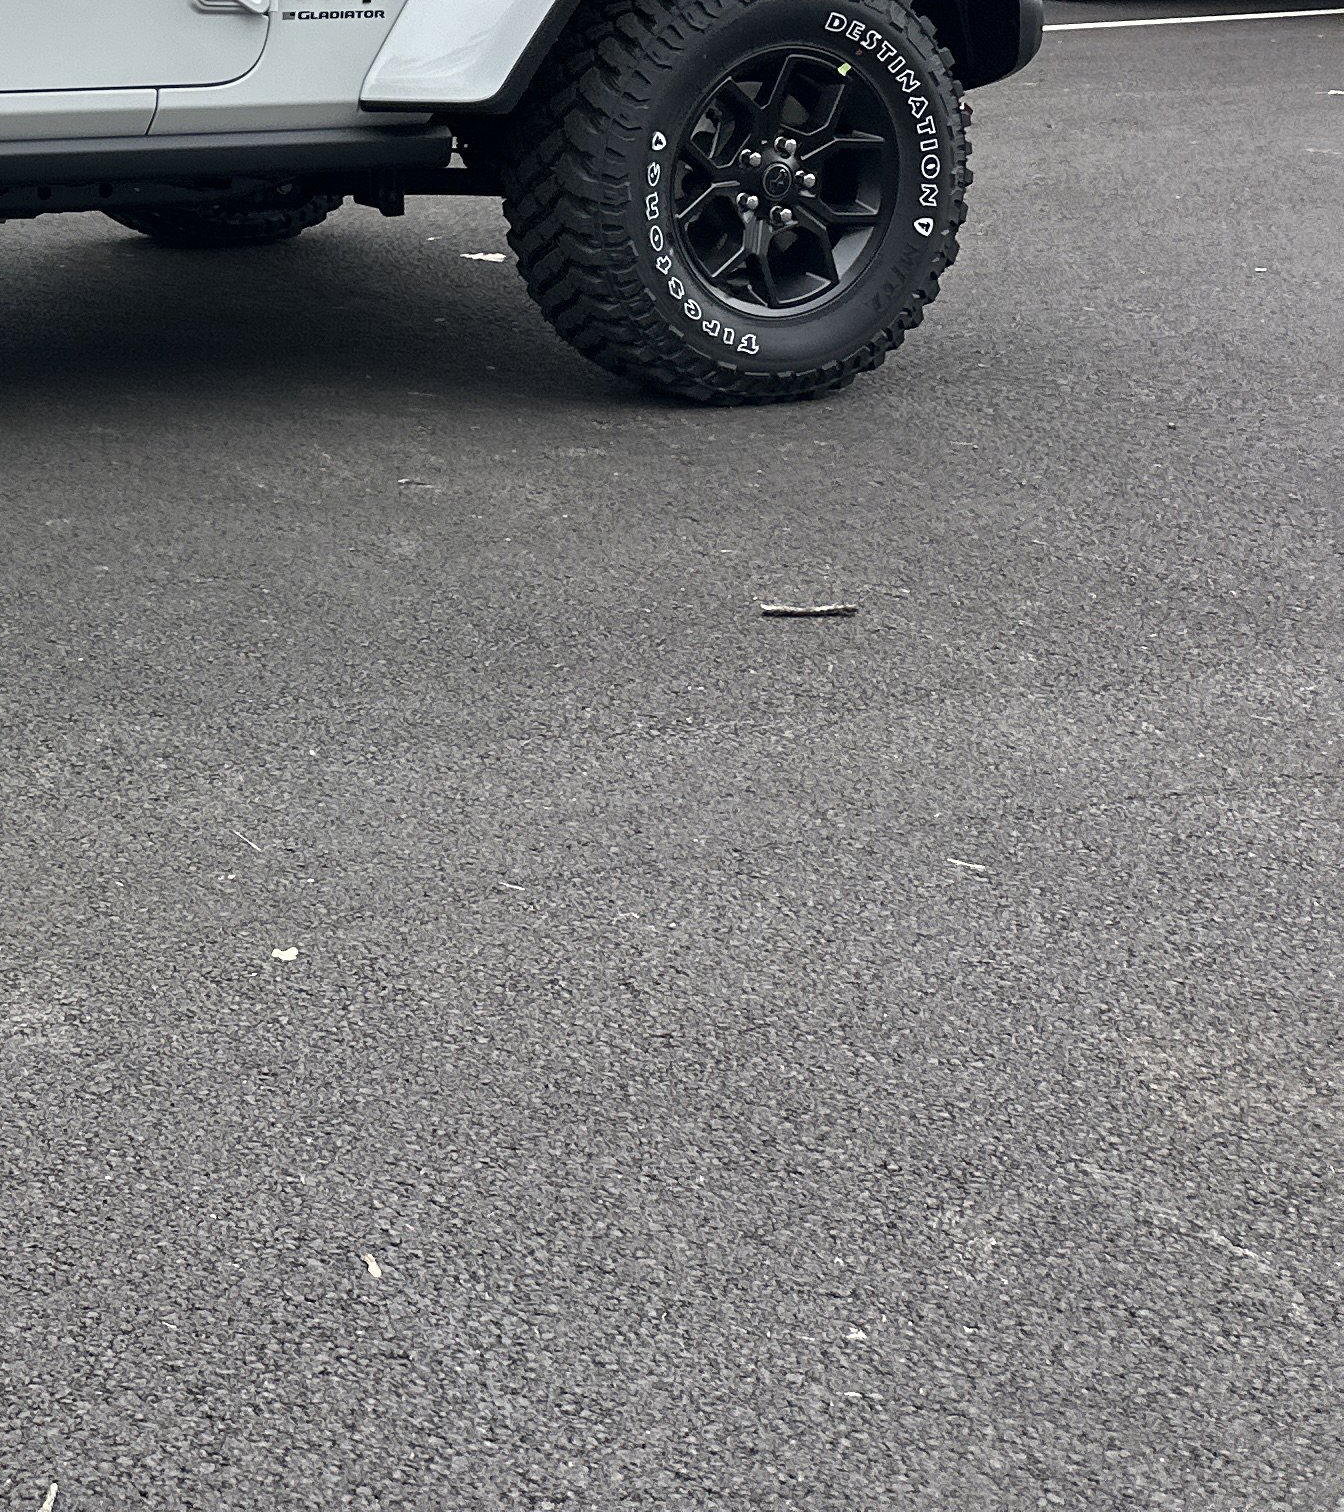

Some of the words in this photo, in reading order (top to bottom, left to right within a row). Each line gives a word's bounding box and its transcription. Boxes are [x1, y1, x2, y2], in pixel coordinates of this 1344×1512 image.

[297, 9, 386, 21] GLADIATOR
[824, 11, 941, 207] DESTINATION
[645, 161, 760, 355] Firestone
